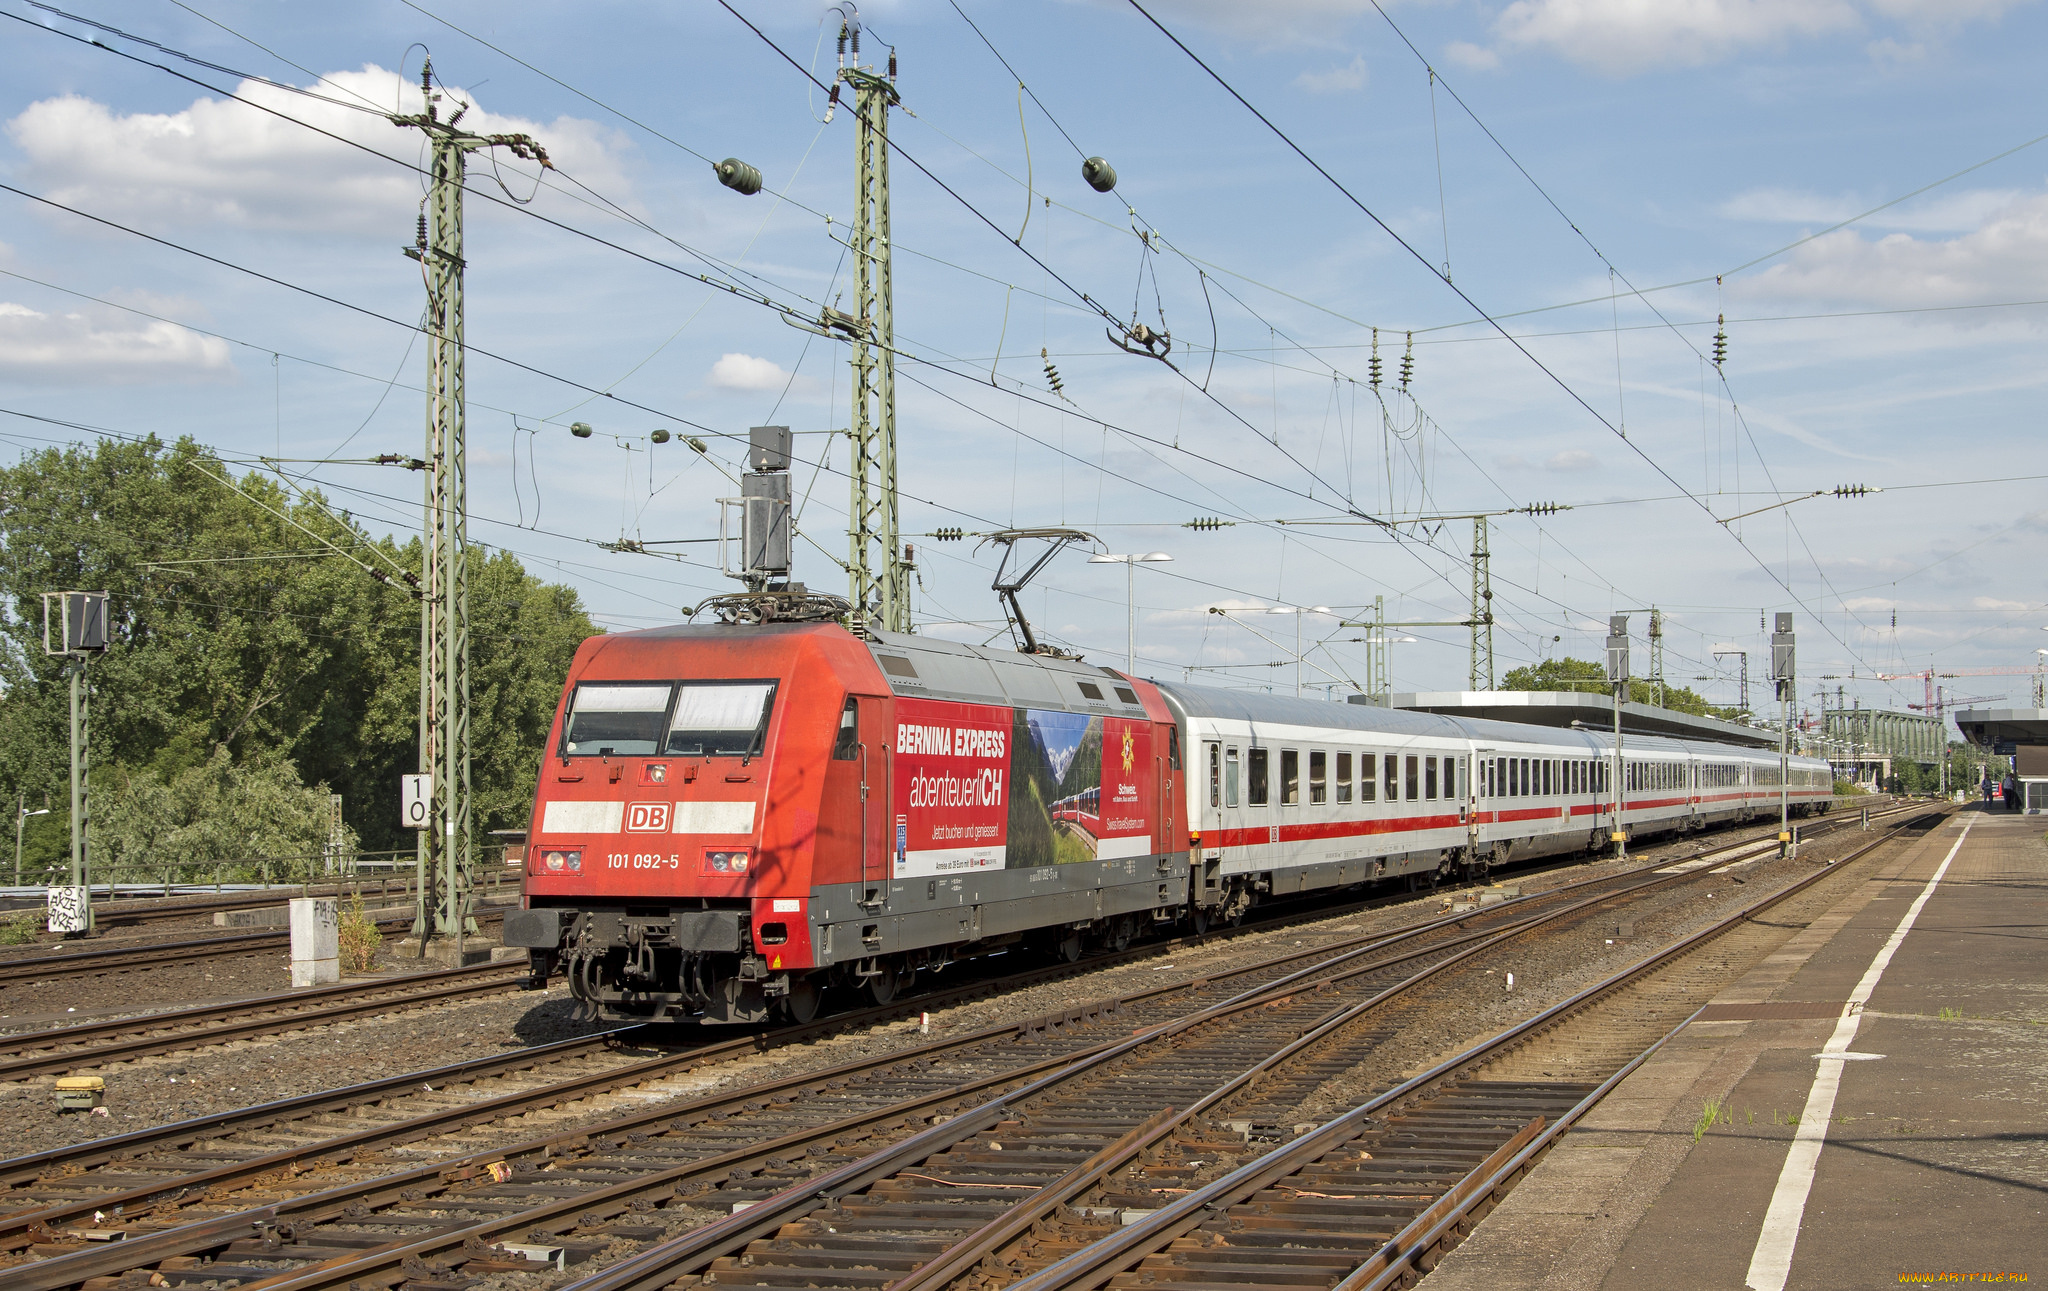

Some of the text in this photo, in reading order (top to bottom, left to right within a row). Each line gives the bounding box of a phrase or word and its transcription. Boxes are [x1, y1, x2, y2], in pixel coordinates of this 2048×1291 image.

[896, 723, 1005, 759] BERNINA EXPRESS
[413, 777, 420, 798] 1
[909, 766, 1003, 807] abenteuerliCH
[410, 801, 425, 821] 0
[630, 805, 667, 830] DB
[931, 824, 945, 840] Jetzt
[945, 824, 964, 839] buchen
[964, 823, 975, 839] und
[607, 853, 679, 869] 101 092-5
